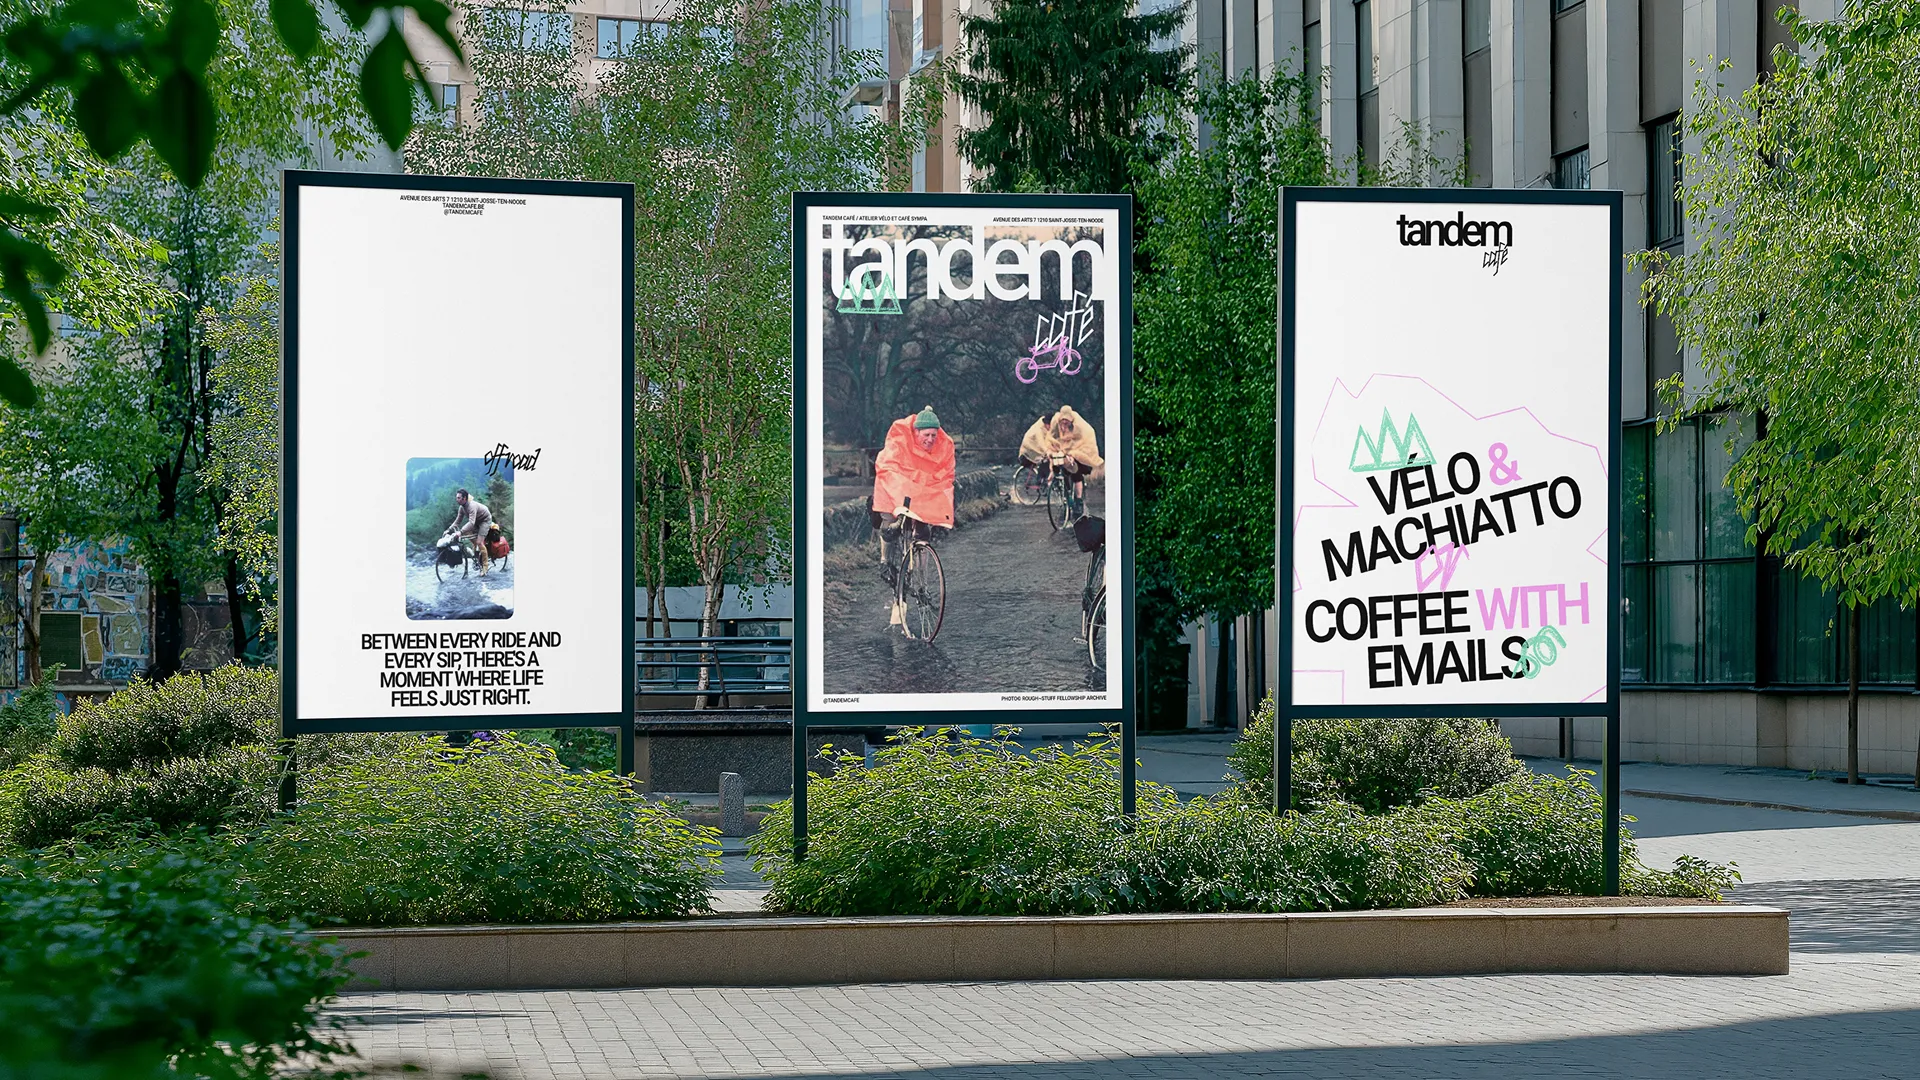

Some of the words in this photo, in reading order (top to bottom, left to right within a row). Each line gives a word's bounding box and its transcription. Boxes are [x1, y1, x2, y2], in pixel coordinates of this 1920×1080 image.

[464, 197, 526, 206] SAINT-JOSSE-TEN-NOODE
[1396, 211, 1513, 247] tandem
[822, 223, 1104, 300] tandem
[1482, 242, 1509, 276] café
[1035, 289, 1094, 374] café
[1366, 452, 1481, 516] VÉLO
[1488, 442, 1523, 486] &
[1321, 476, 1582, 582] MACHIATTO
[1305, 590, 1471, 643] COFFEE
[1475, 582, 1590, 631] WITH
[362, 633, 437, 650] BETWEEN
[440, 632, 490, 649] EVERY
[492, 632, 526, 648] RIDE
[528, 632, 562, 648] AND
[384, 652, 434, 668] EVERY
[436, 652, 462, 670] SIP,
[463, 650, 526, 668] THERE'S
[528, 651, 540, 666] A
[1368, 636, 1530, 689] EMAILS
[380, 671, 453, 688] MOMENT
[454, 670, 511, 686] WHERE
[512, 670, 544, 686] LIFE
[392, 690, 438, 706] FEELS
[440, 690, 480, 706] JUST
[482, 688, 531, 706] RIGHT.
